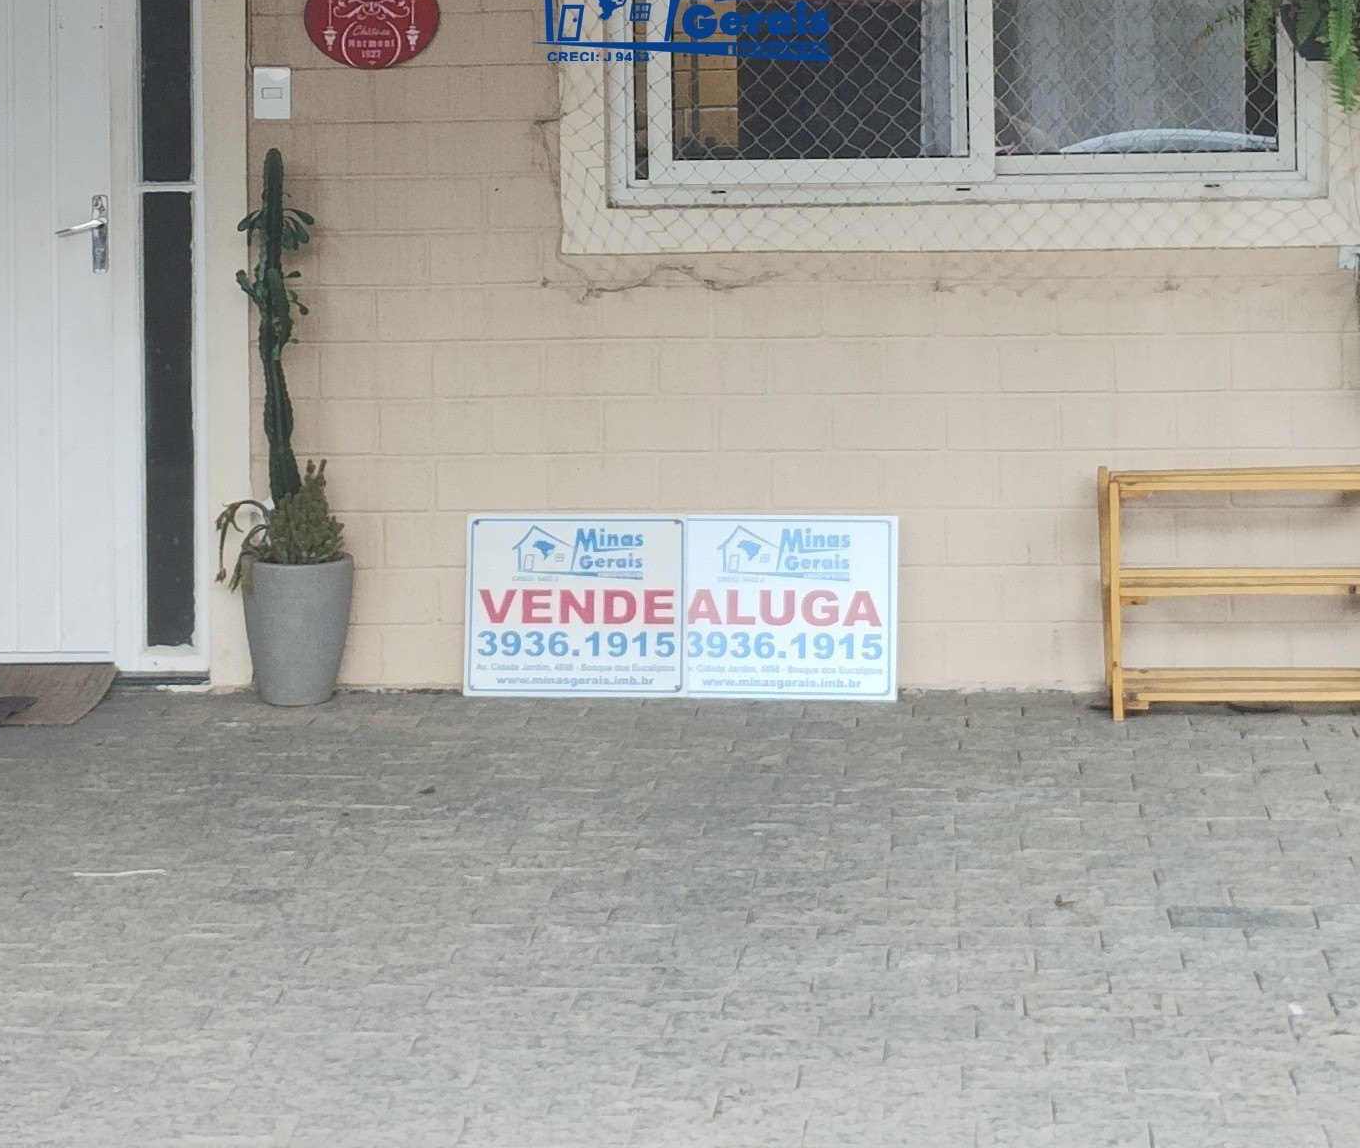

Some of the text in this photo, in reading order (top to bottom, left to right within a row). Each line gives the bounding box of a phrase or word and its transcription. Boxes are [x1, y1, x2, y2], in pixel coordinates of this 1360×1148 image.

[575, 527, 645, 552] Minas
[780, 527, 851, 553] Minas
[578, 553, 644, 570] Gerais
[784, 553, 850, 571] Gerais
[478, 589, 675, 624] VENDE
[687, 589, 882, 627] ALUGA
[477, 630, 676, 658] 3936.1915
[687, 631, 883, 660] 3936.1915
